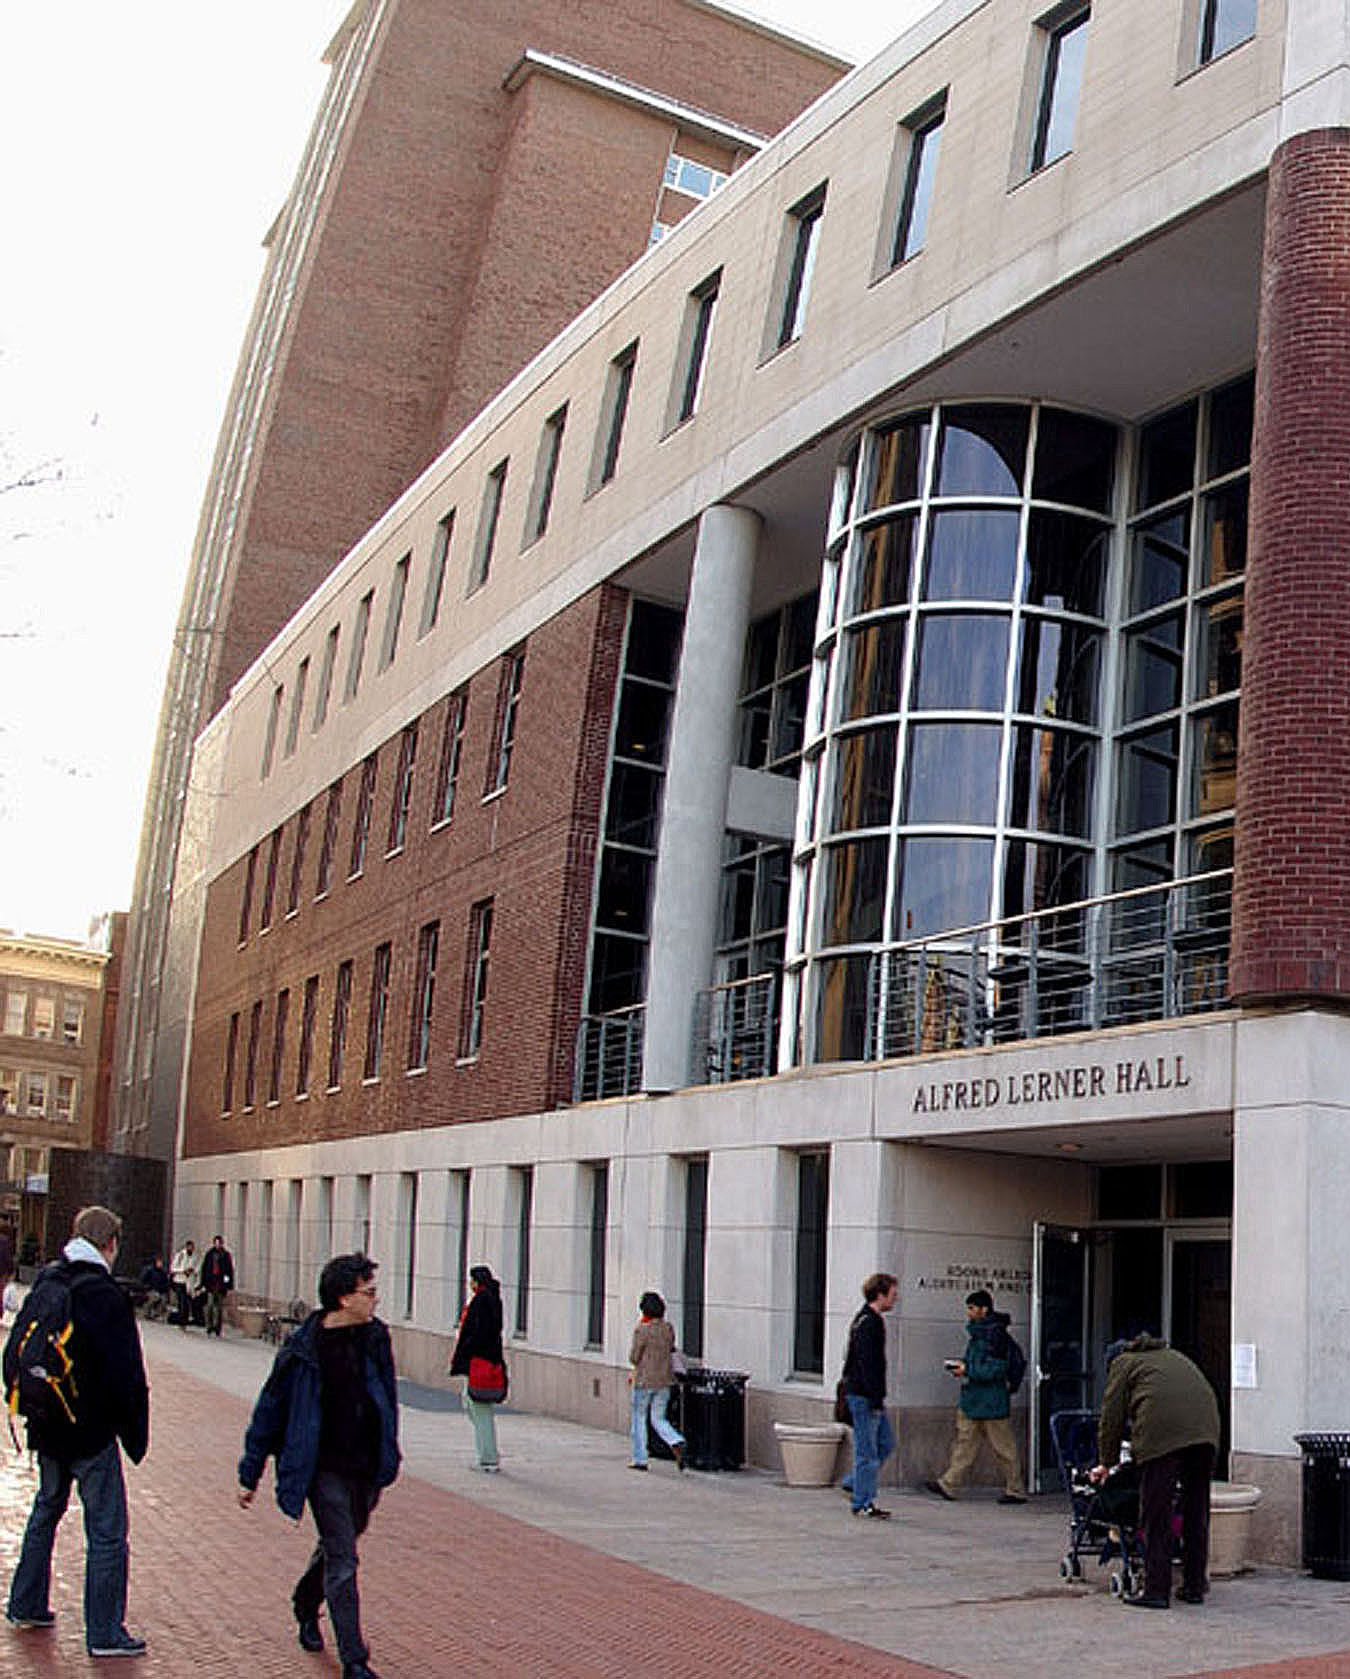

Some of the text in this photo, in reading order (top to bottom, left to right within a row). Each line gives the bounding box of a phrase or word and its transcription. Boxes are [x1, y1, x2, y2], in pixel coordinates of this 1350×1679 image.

[913, 1055, 1192, 1113] ALFRED LERNER HALL
